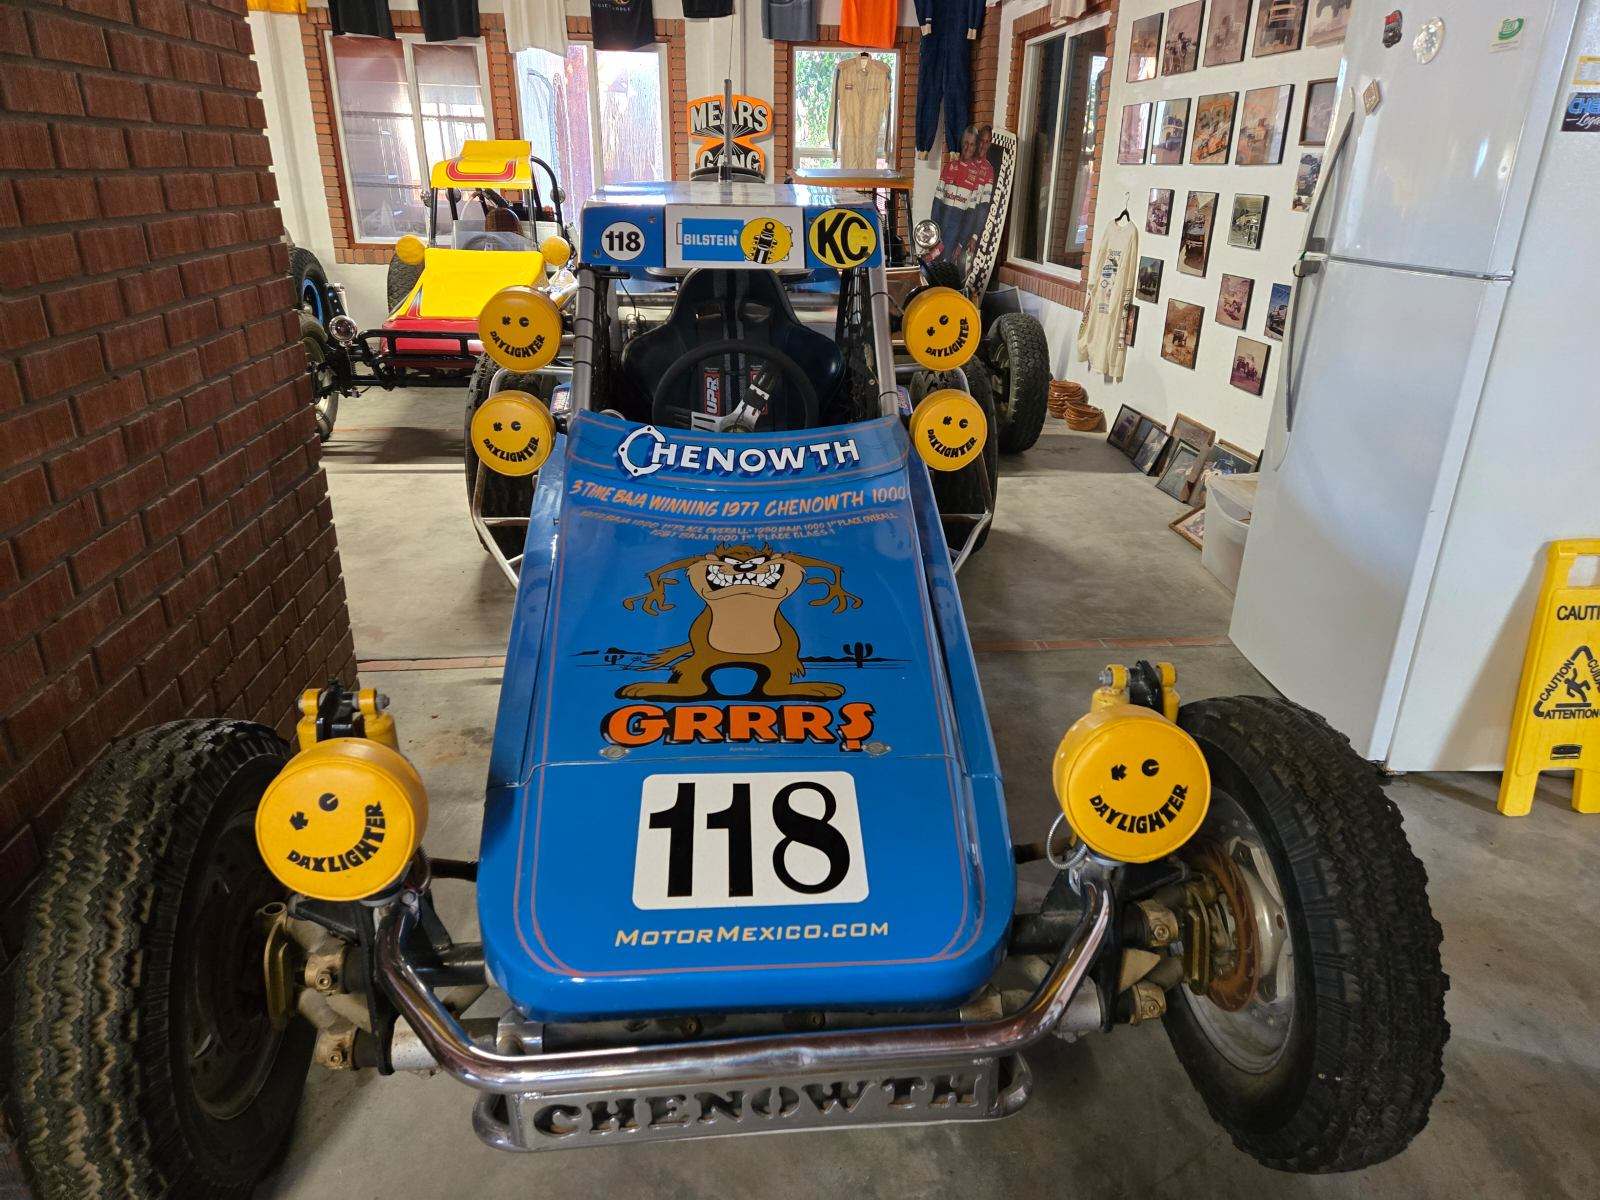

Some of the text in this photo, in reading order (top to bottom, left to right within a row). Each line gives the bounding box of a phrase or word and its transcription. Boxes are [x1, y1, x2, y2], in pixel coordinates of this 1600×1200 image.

[691, 100, 768, 133] MEARS
[604, 230, 642, 252] 118
[683, 233, 738, 247] BILSTEIN
[817, 212, 869, 265] KC
[489, 329, 546, 359] DAYLIGHTER
[925, 316, 970, 358] DAYLIGHTER
[482, 436, 540, 463] DAYLIGHTER
[617, 424, 861, 477] CHENOWTH
[927, 428, 978, 459] DAYLIGHTER
[569, 479, 906, 518] 3 TIME BAJA WINNING 1977 CHENOWTH 1000
[712, 533, 738, 541] 1000
[1540, 659, 1575, 703] CAUTION
[1543, 707, 1598, 720] ATTENTION
[1089, 783, 1189, 834] DAYLIGHTER
[286, 800, 387, 873] DAYLIGHTER
[648, 780, 851, 898] 118
[614, 921, 890, 947] MOTORMEXICO.COM
[533, 1073, 983, 1139] CHENOWTH
